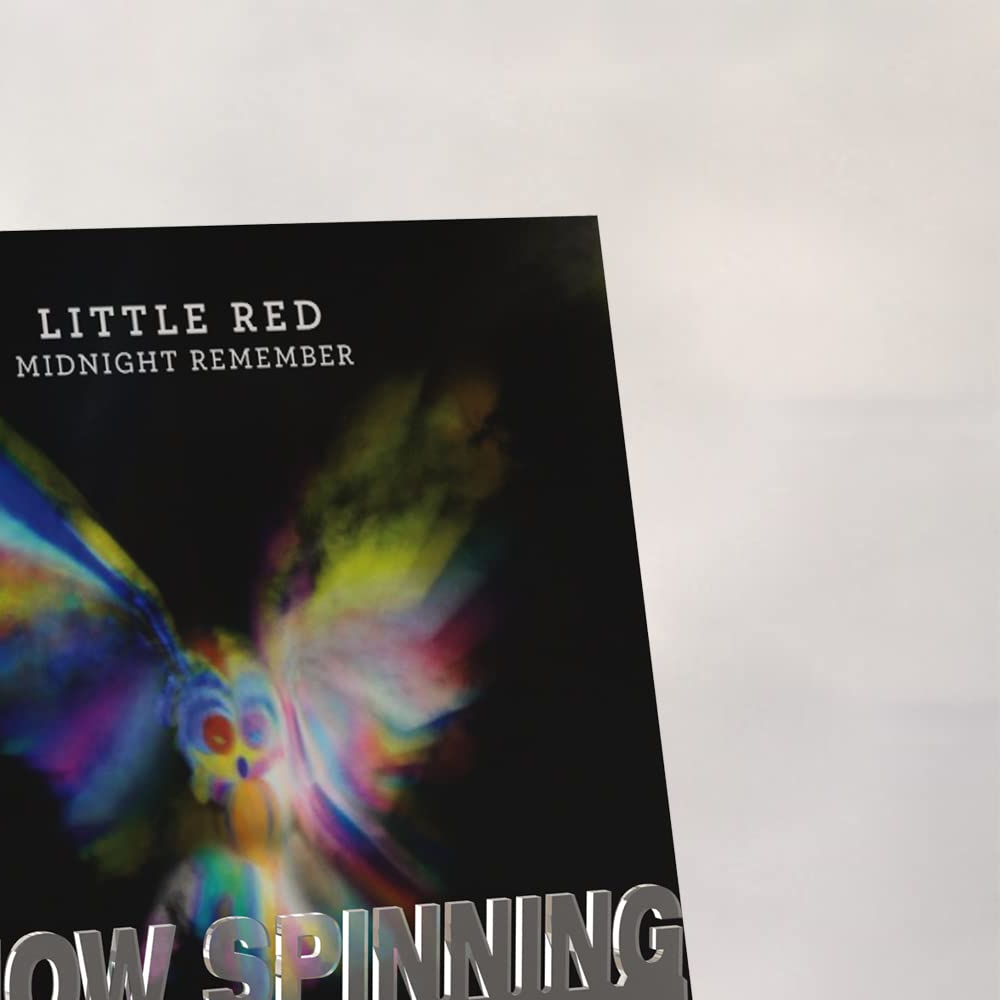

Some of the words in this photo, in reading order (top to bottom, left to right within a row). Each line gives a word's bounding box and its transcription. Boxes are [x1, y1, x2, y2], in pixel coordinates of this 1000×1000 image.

[37, 303, 208, 339] LITTLE
[230, 300, 322, 333] RED
[15, 350, 177, 377] MIDNIGHT
[190, 344, 355, 371] REMEMBER
